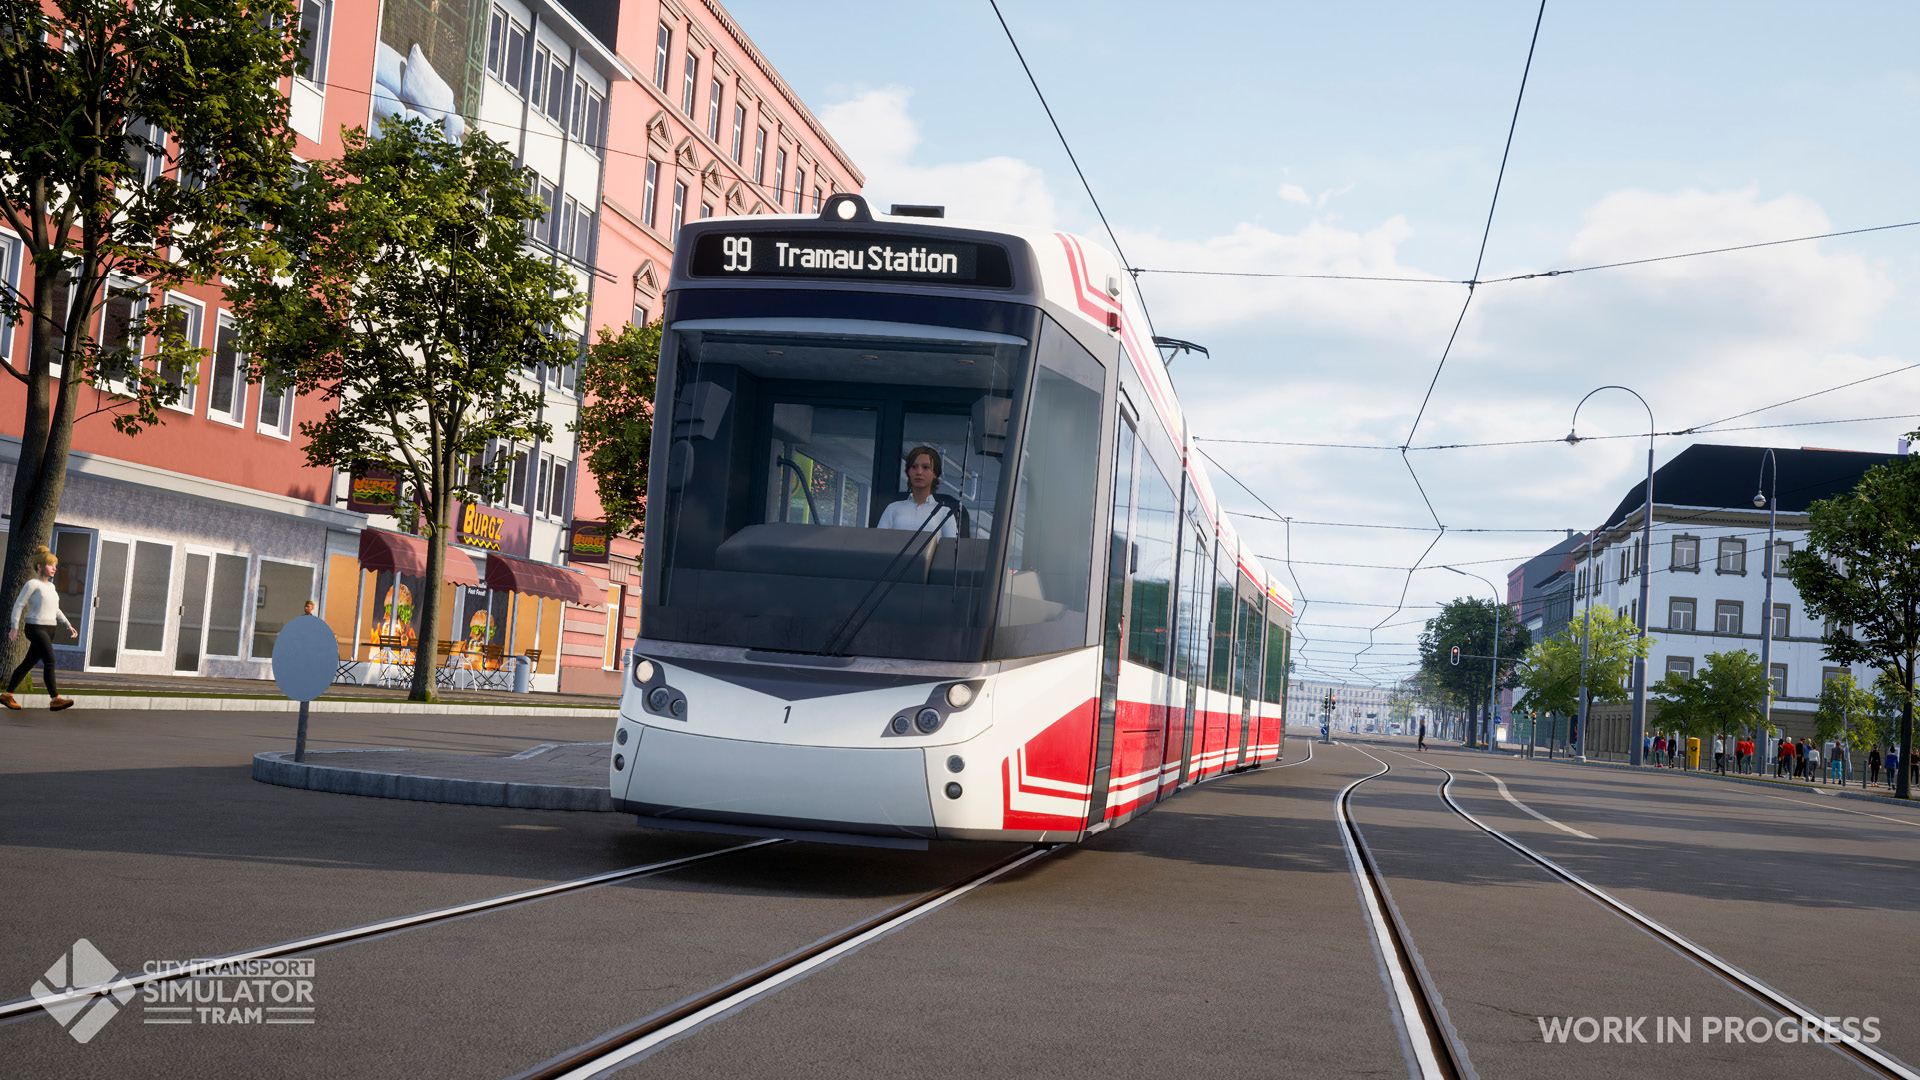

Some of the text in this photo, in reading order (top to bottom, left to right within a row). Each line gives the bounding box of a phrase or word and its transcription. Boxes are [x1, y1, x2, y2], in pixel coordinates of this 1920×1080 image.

[723, 236, 958, 273] 99 Tramau Station
[783, 705, 792, 724] 1
